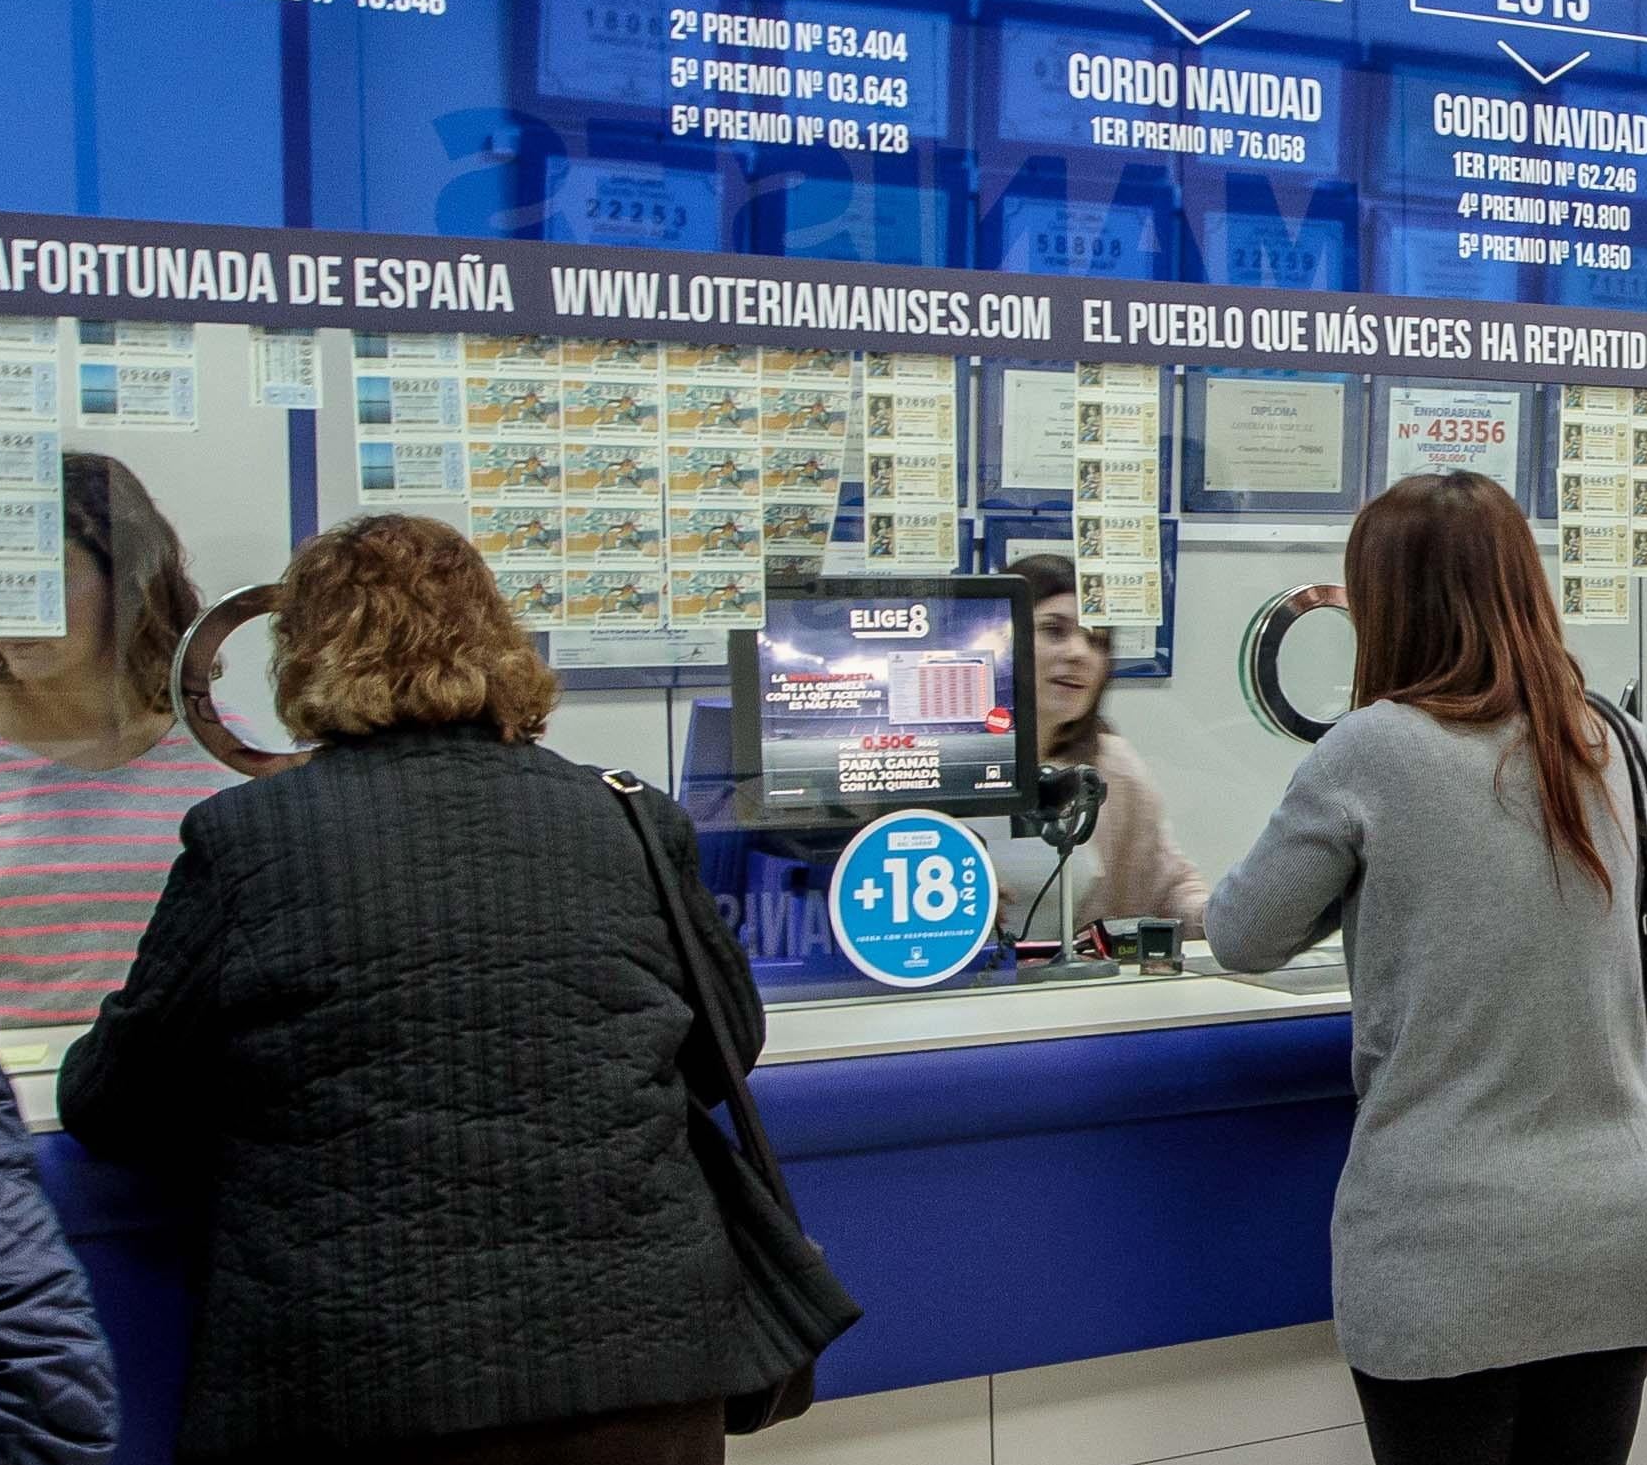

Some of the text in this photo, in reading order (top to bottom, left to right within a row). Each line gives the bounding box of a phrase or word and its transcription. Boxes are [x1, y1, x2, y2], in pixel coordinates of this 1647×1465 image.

[669, 8, 698, 41] 2º
[701, 12, 790, 52] PREMIO
[794, 22, 823, 54] Nº
[826, 26, 908, 63] 53.404
[670, 56, 909, 109] 5º PREMIO Nº 03.643
[1067, 52, 1323, 123] GORDO NAVIDAD
[671, 104, 910, 154] 5º PREMIO Nº 08.128
[1090, 116, 1306, 164] 1ER PREMIO Nº 76.058
[1433, 92, 1529, 144] GORDO
[1452, 151, 1637, 193] 1ER PREMIO Nº 62.246
[1457, 192, 1631, 232] 4º PREMIO Nº 79.800
[1458, 232, 1632, 271] 5º PREMIO Nº 14.850
[287, 253, 344, 307] DE
[353, 253, 514, 313] ESPAÑA
[551, 266, 1052, 341] WWW.LOTERIAMANISES.COM
[1082, 298, 1122, 344] EL
[1127, 300, 1245, 350] PUEBLO
[1250, 307, 1309, 353] QUE
[1314, 304, 1379, 356] MÁS
[1382, 314, 1473, 360] VECES
[1480, 321, 1519, 365] HA
[1398, 419, 1506, 444] Nº 43356
[1413, 405, 1492, 419] ENHORABUENA
[838, 757, 941, 772] PARA GANAR
[839, 769, 941, 783] CADA JORNADA
[839, 779, 941, 793] CON LA QUINIELA
[853, 854, 959, 924] +18
[959, 855, 977, 917] AÑOS
